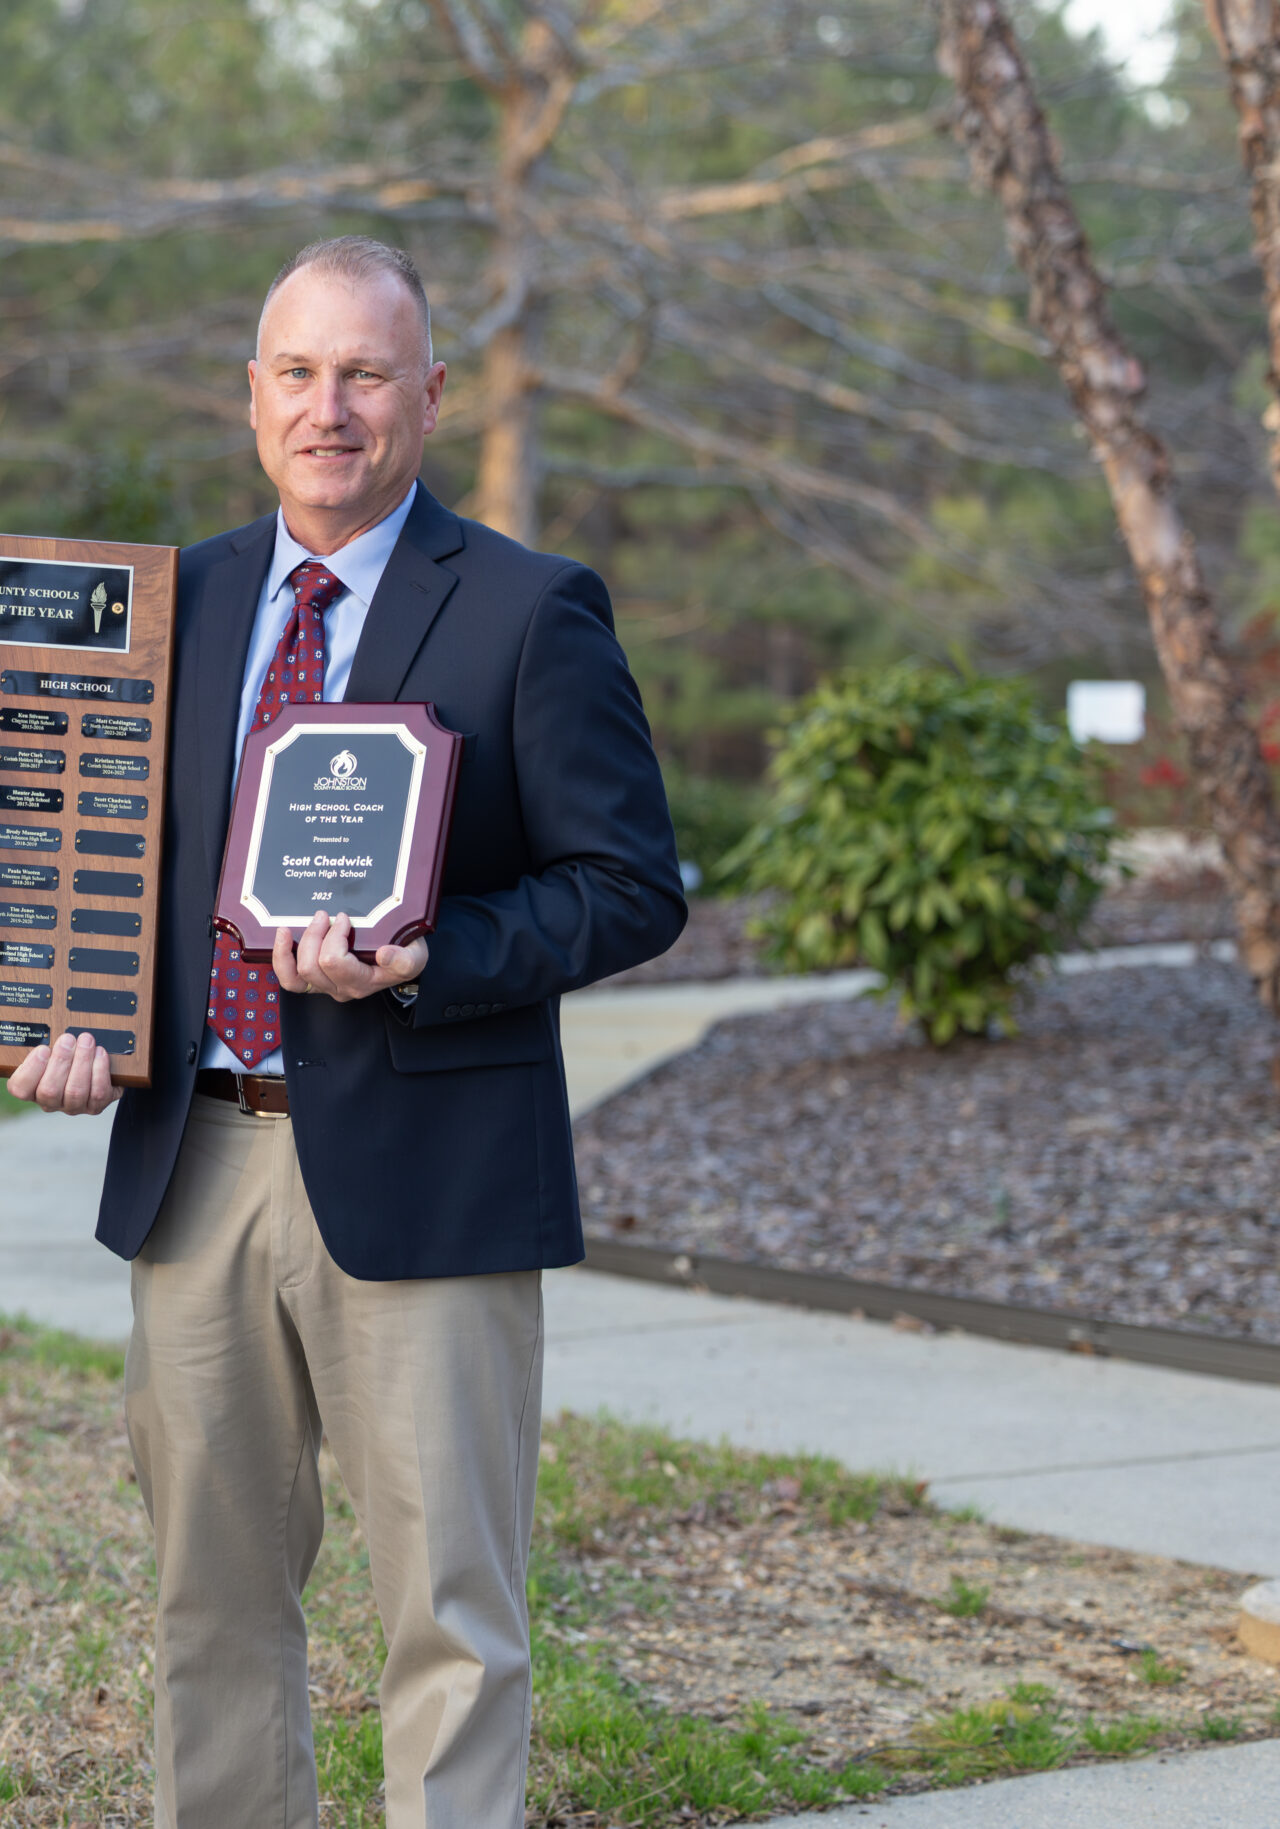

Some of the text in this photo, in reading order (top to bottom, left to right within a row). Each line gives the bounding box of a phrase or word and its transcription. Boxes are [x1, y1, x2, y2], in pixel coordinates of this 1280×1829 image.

[29, 588, 79, 600] SCHOOLS
[9, 605, 35, 618] THE
[38, 607, 74, 620] YEAR
[40, 680, 114, 693] HIGH SCHOOL
[314, 777, 367, 786] JOHNSTON
[289, 803, 384, 812] HIGH SCHOOL COACH
[340, 815, 364, 824] YEAR
[282, 855, 373, 867] Scott Chadwick
[284, 869, 367, 879] Clayton High School
[311, 892, 333, 901] 2025
